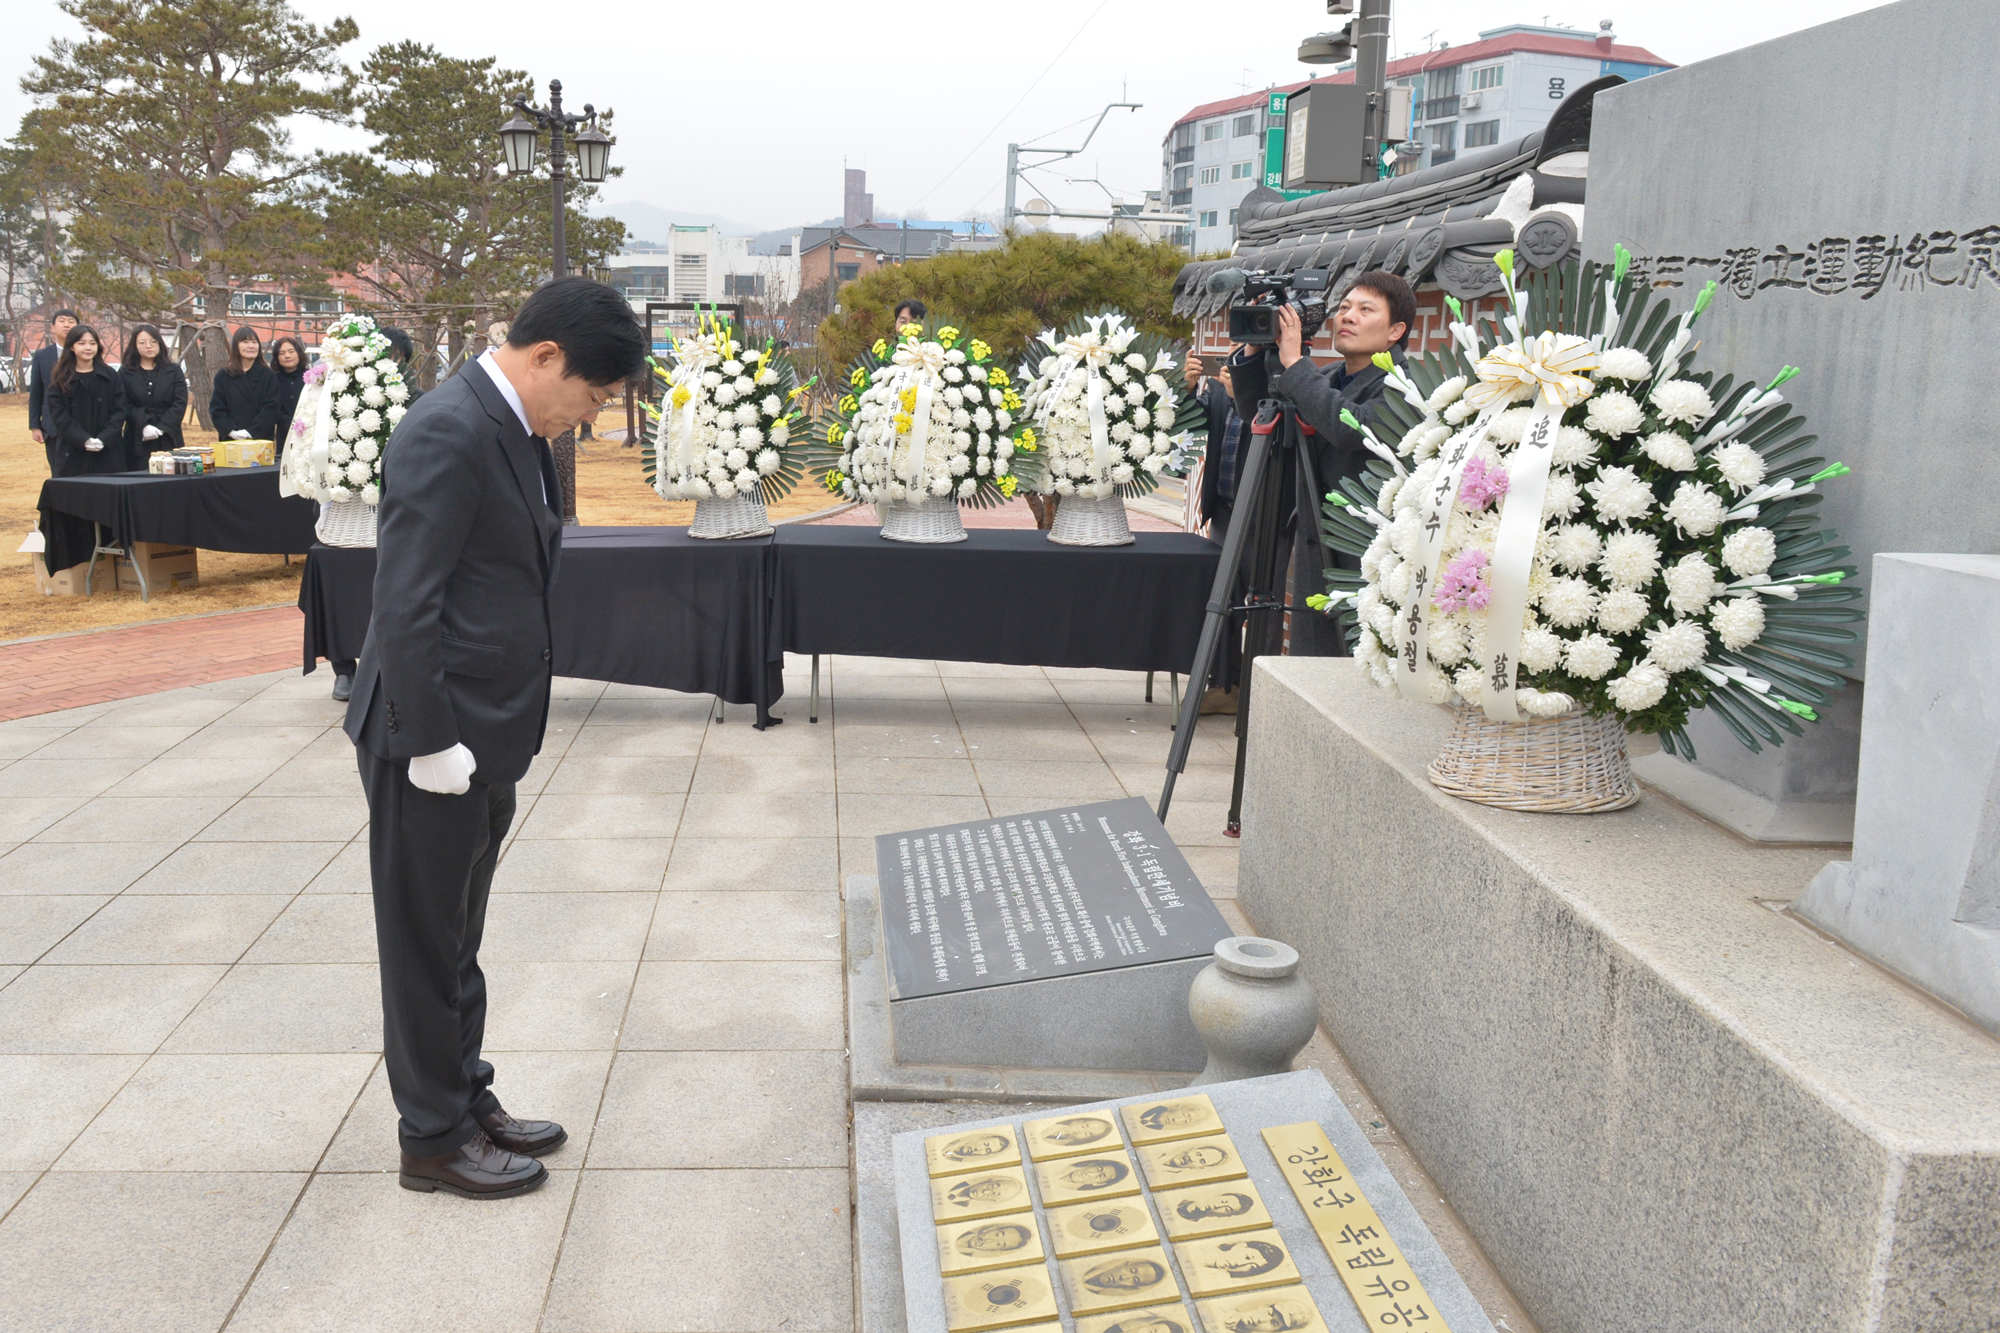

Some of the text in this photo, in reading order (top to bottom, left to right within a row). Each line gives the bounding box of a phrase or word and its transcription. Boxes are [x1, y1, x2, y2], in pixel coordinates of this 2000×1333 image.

[1548, 77, 1565, 99] 용
[1403, 414, 1492, 674] 강화군수 박용철
[1491, 414, 1550, 694] 追 慕
[1123, 830, 1183, 907] 강화 3·1 독립만세기념비
[1287, 1146, 1431, 1333] 강화군 독립유공
